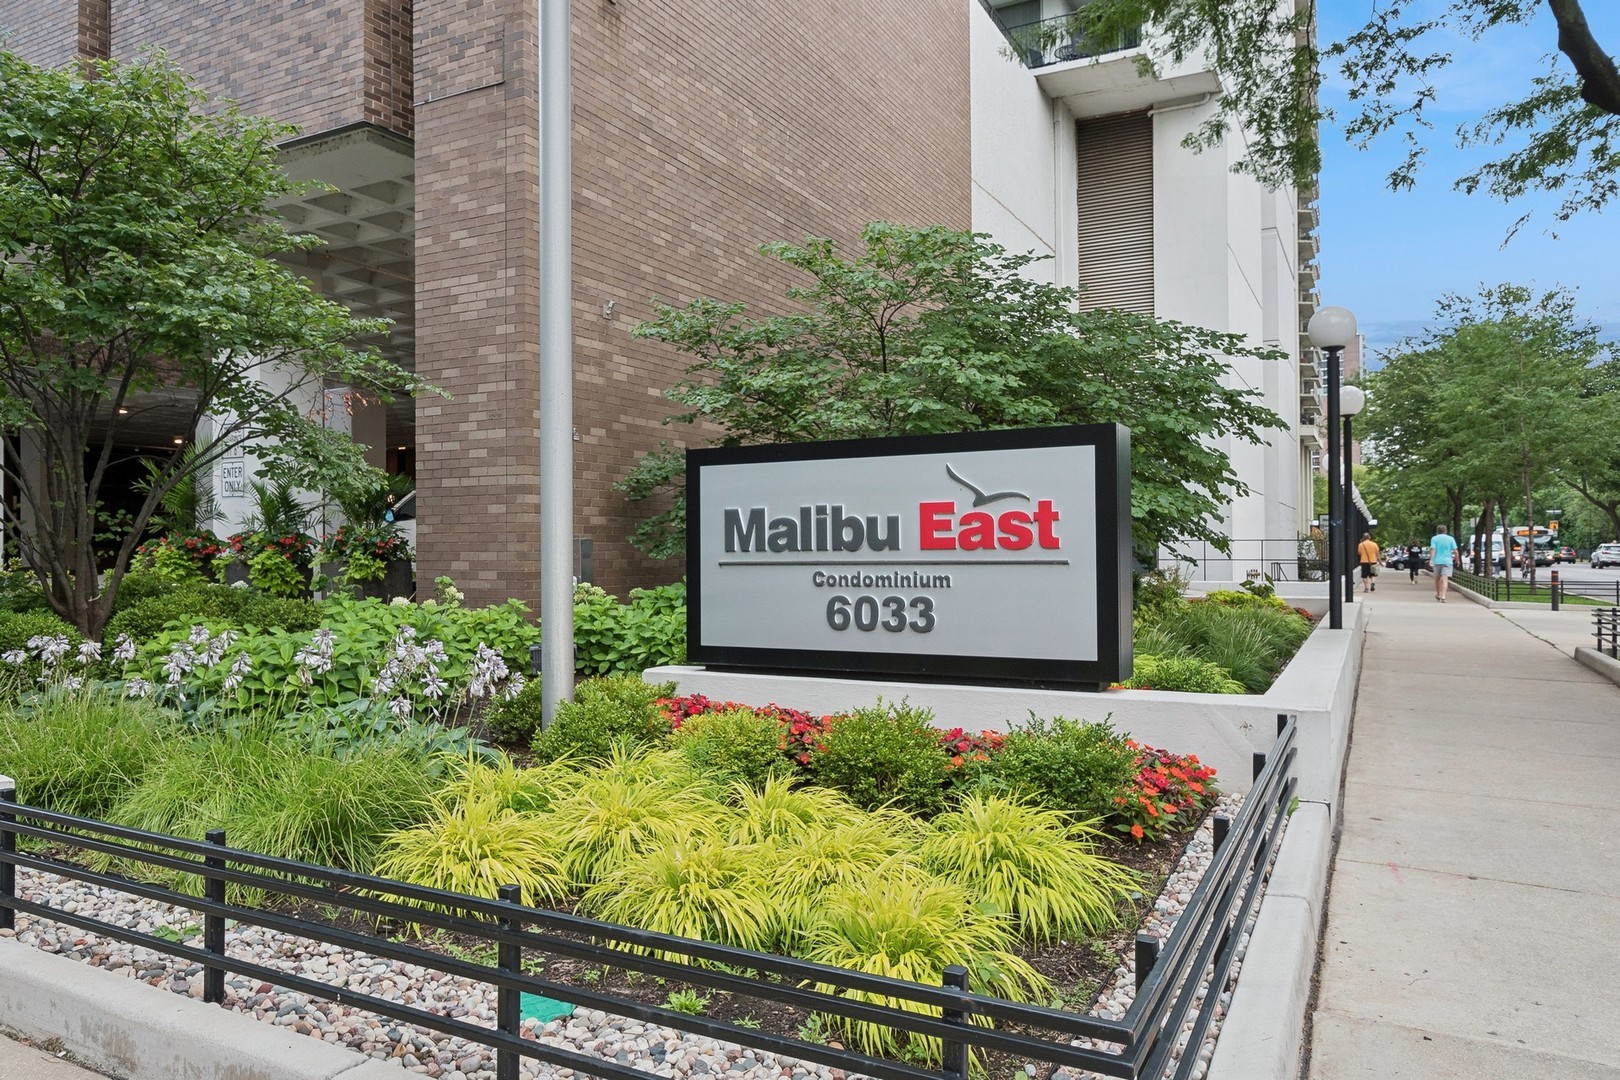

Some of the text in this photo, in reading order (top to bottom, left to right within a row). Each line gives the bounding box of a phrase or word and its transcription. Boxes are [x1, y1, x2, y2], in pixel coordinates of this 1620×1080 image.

[223, 467, 243, 478] ENTER
[224, 481, 241, 492] ONLY
[724, 500, 1060, 553] Malibu East
[812, 571, 951, 588] Condominium
[826, 595, 936, 633] 6033
